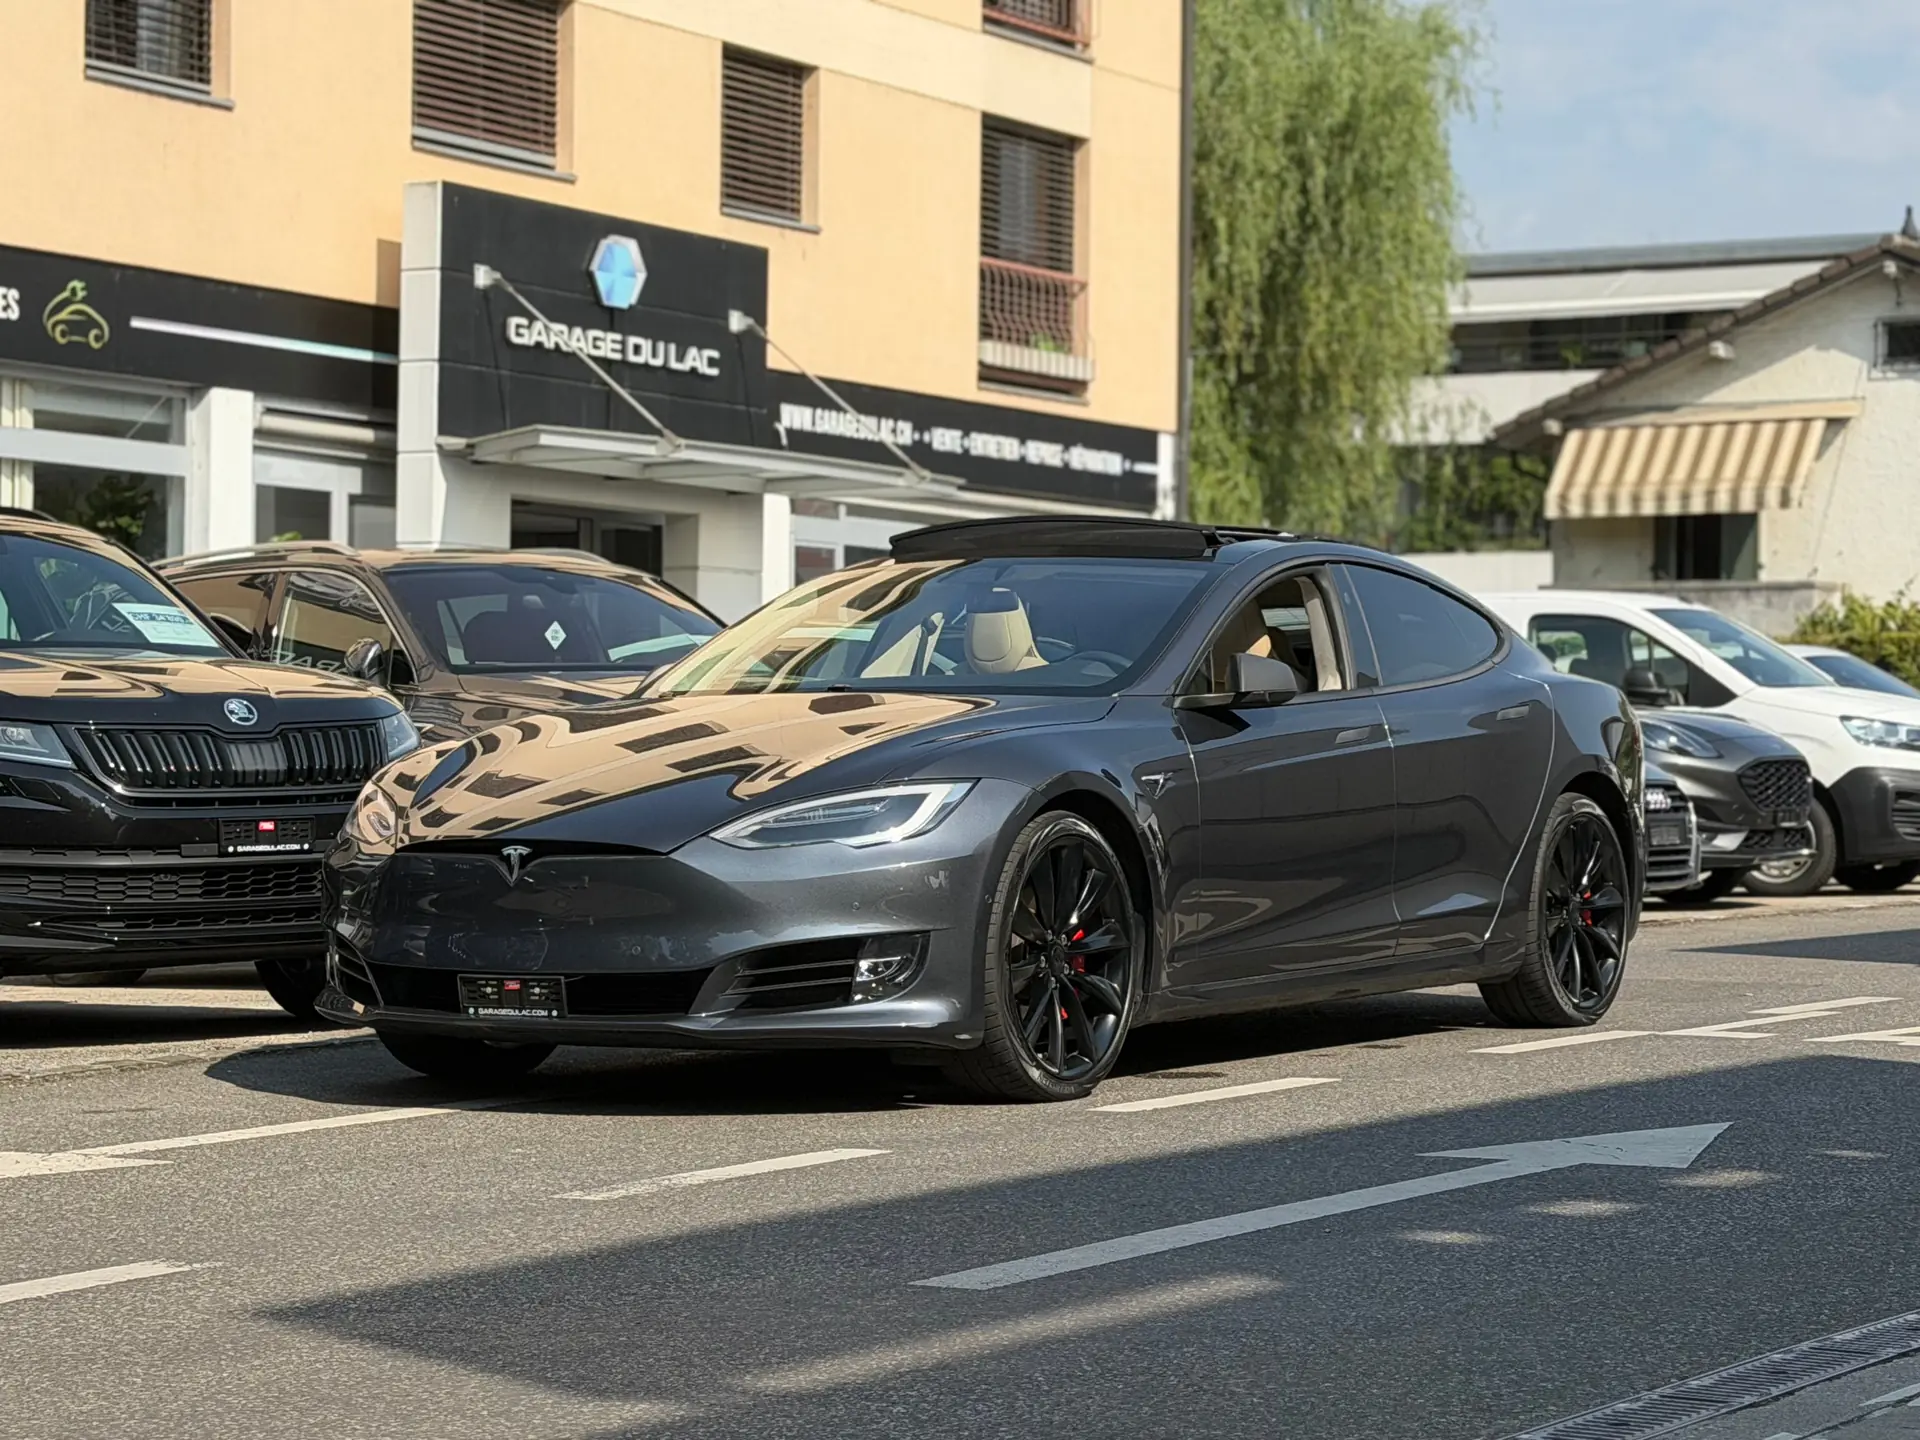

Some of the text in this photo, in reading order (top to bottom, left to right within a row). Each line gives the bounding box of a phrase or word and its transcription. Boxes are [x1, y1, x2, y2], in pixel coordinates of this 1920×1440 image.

[508, 316, 719, 376] GARAGE DU LAC
[478, 1008, 547, 1016] GARAGEDULAC.COM
